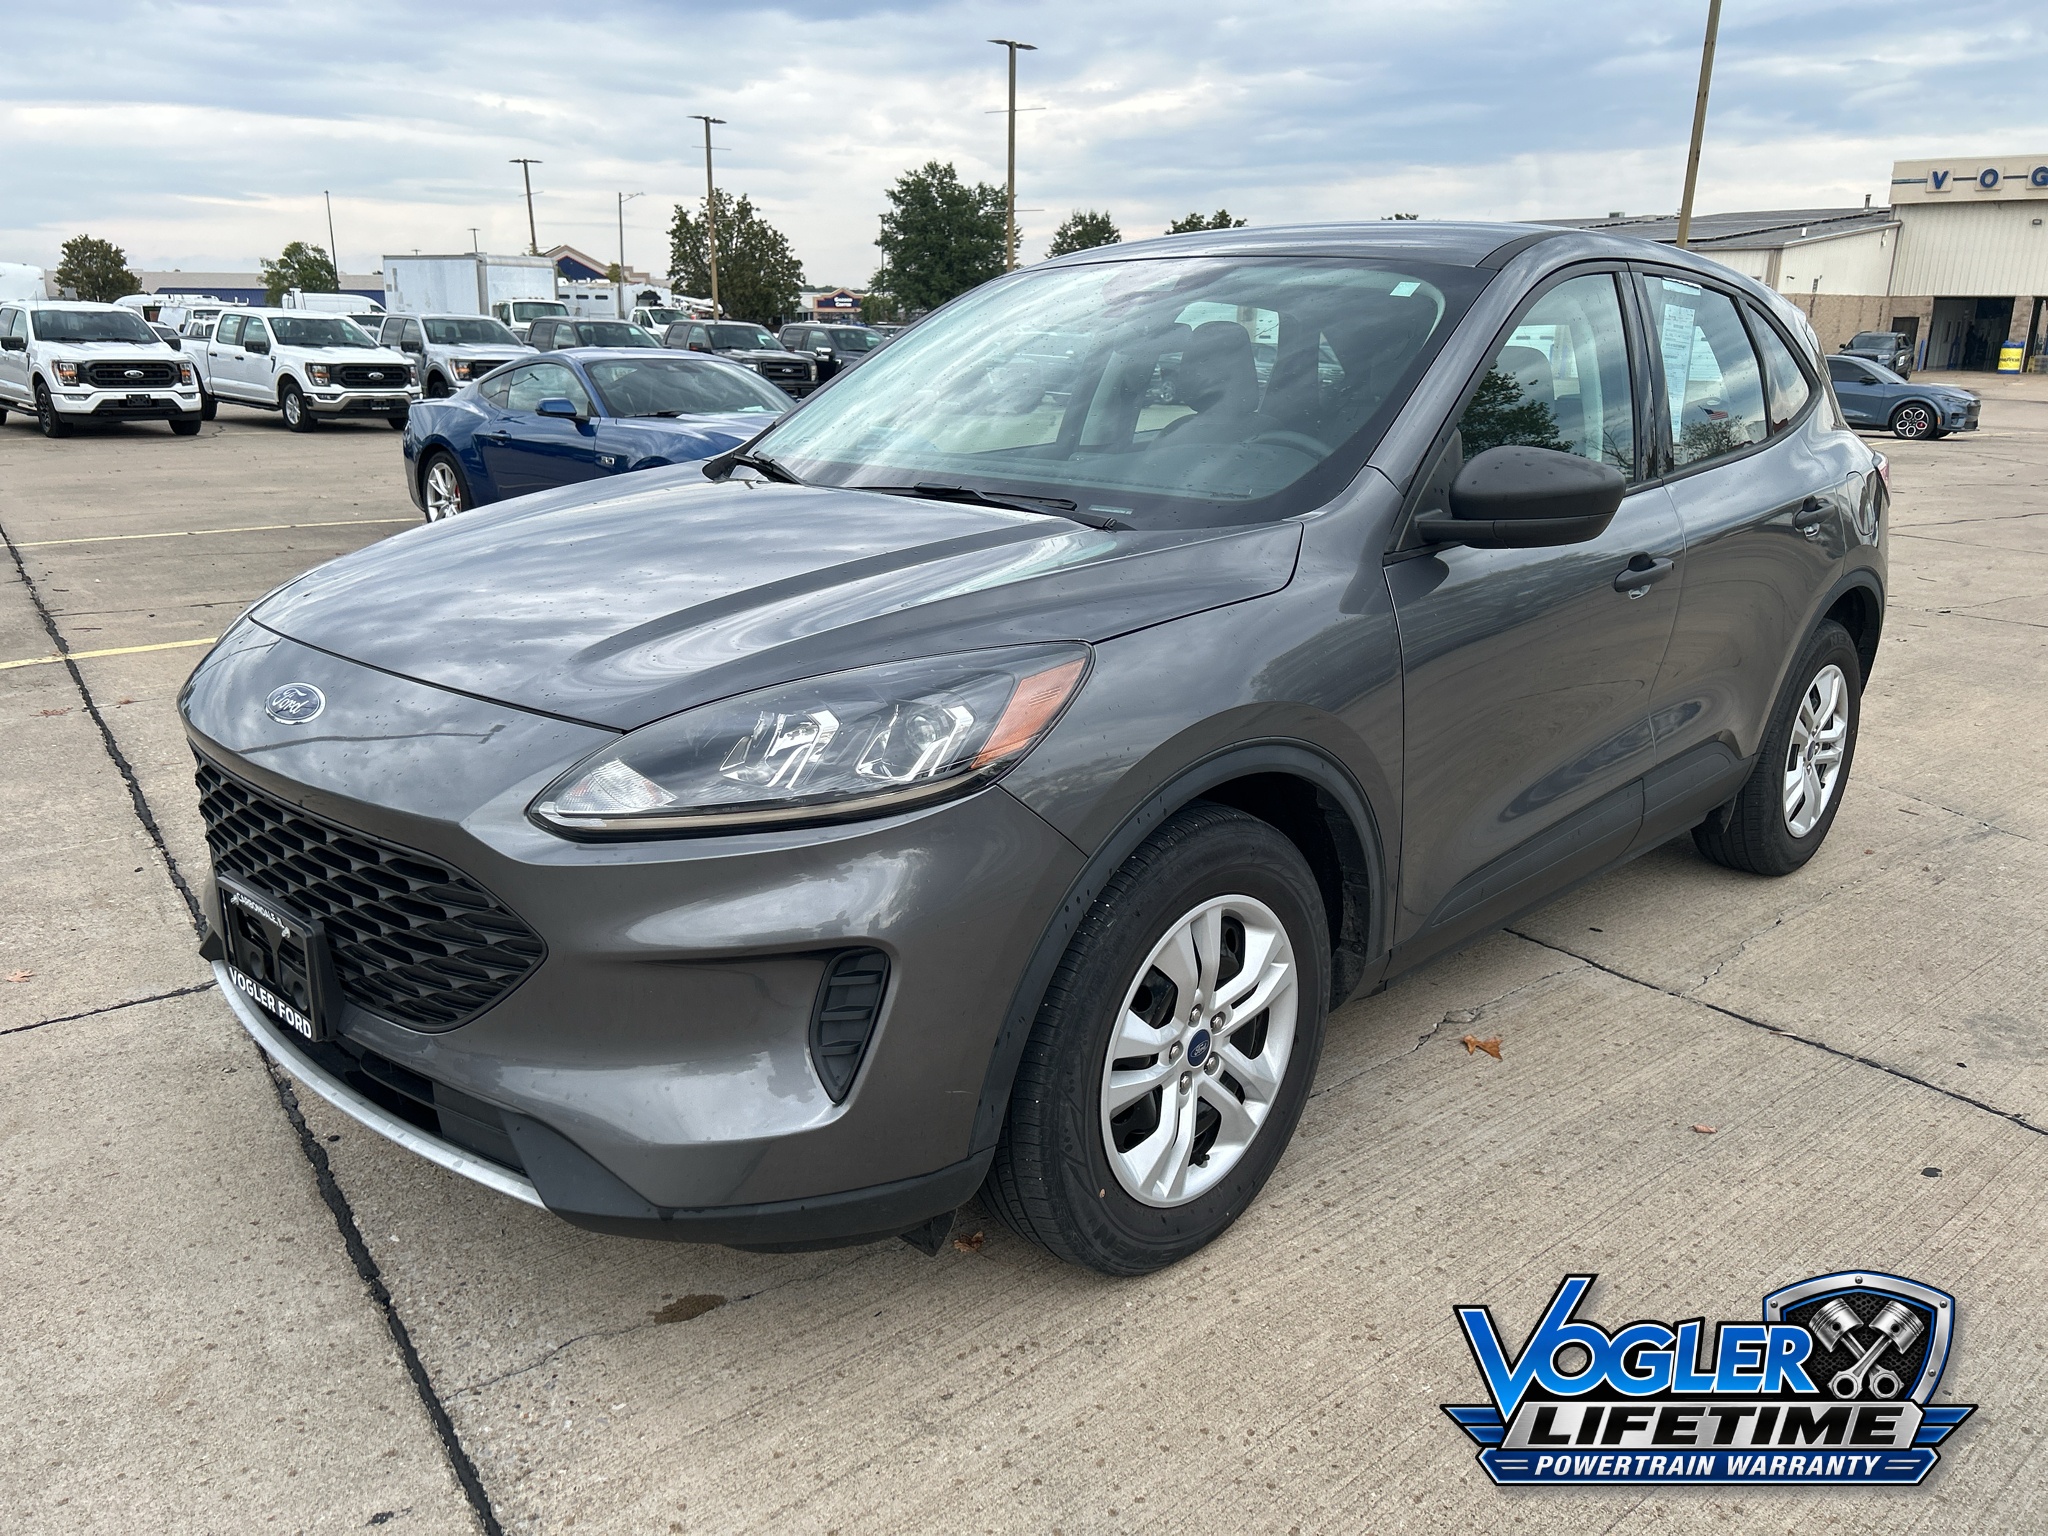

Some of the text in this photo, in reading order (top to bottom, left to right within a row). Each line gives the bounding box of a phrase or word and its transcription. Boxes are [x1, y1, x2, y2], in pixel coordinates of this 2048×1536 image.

[272, 688, 308, 715] Ford
[229, 966, 312, 1039] VOGLER FORD
